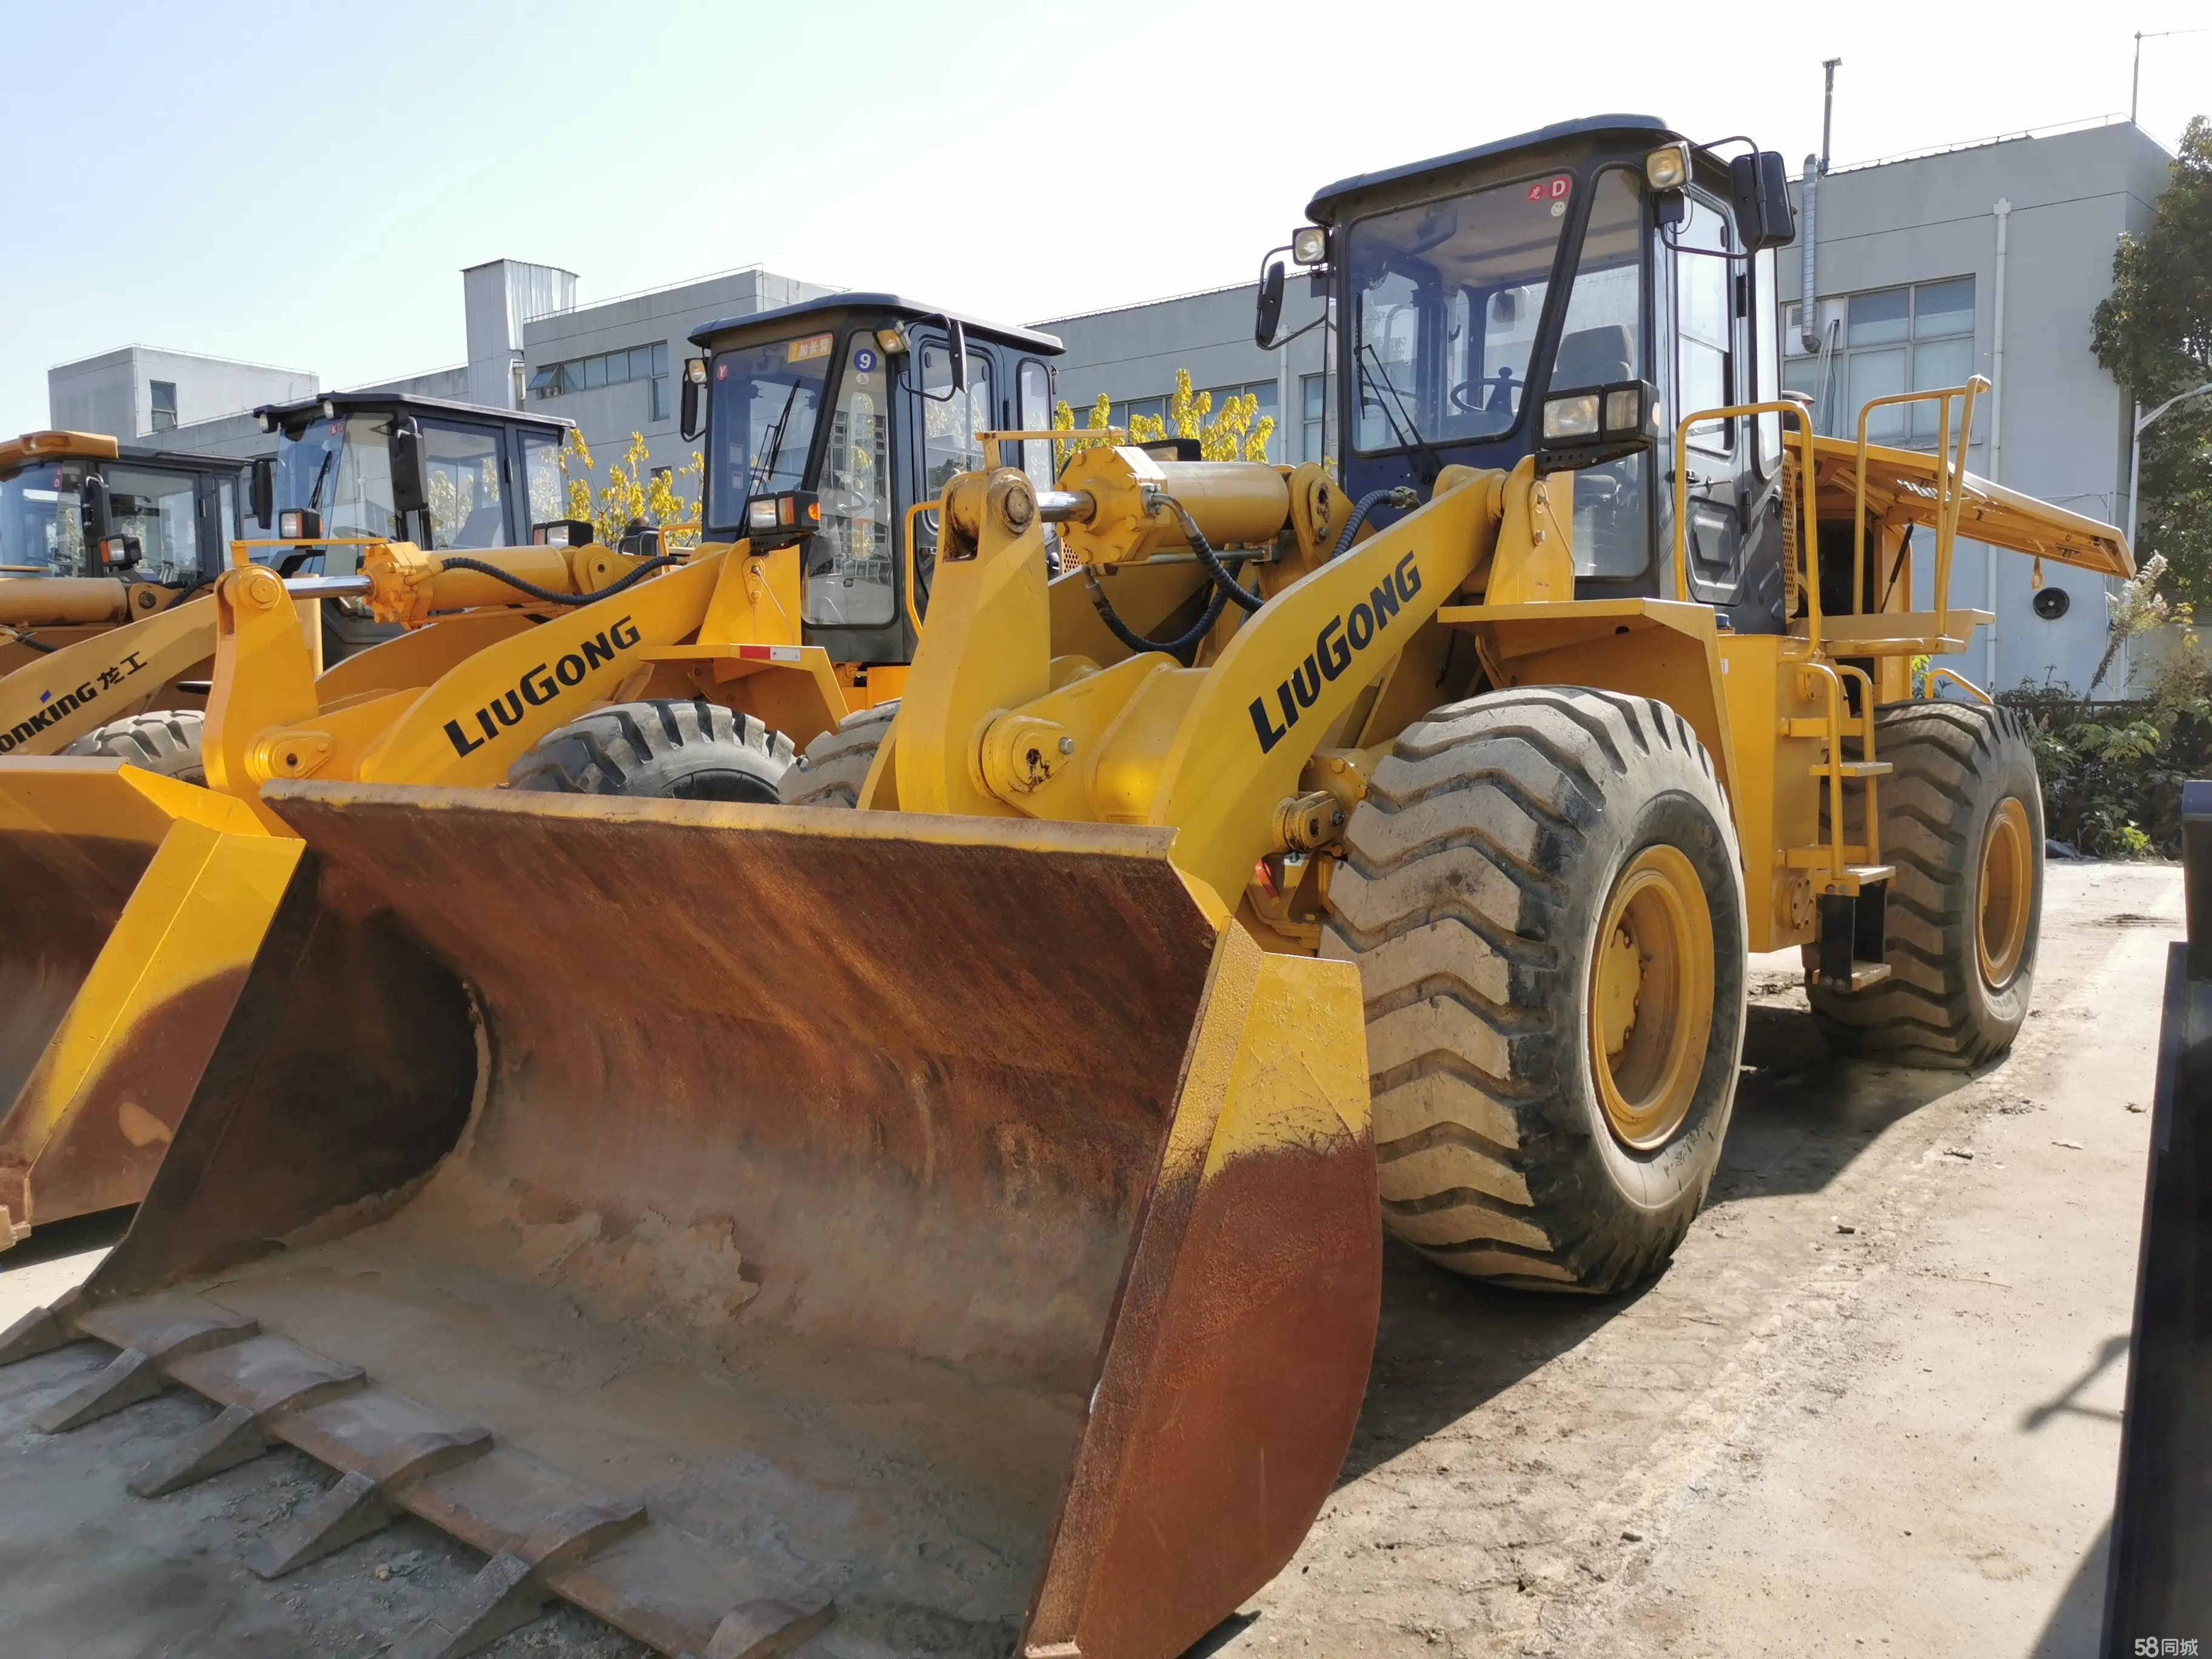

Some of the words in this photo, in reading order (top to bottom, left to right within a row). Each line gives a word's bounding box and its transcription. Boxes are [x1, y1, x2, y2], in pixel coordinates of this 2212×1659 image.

[1552, 180, 1566, 196] D
[720, 366, 726, 377] Y
[859, 353, 871, 369] 9
[1248, 549, 1422, 754] LIUGONG
[0, 682, 98, 755] ONKING
[96, 651, 148, 690] 龙工
[443, 615, 641, 758] LIUGONG
